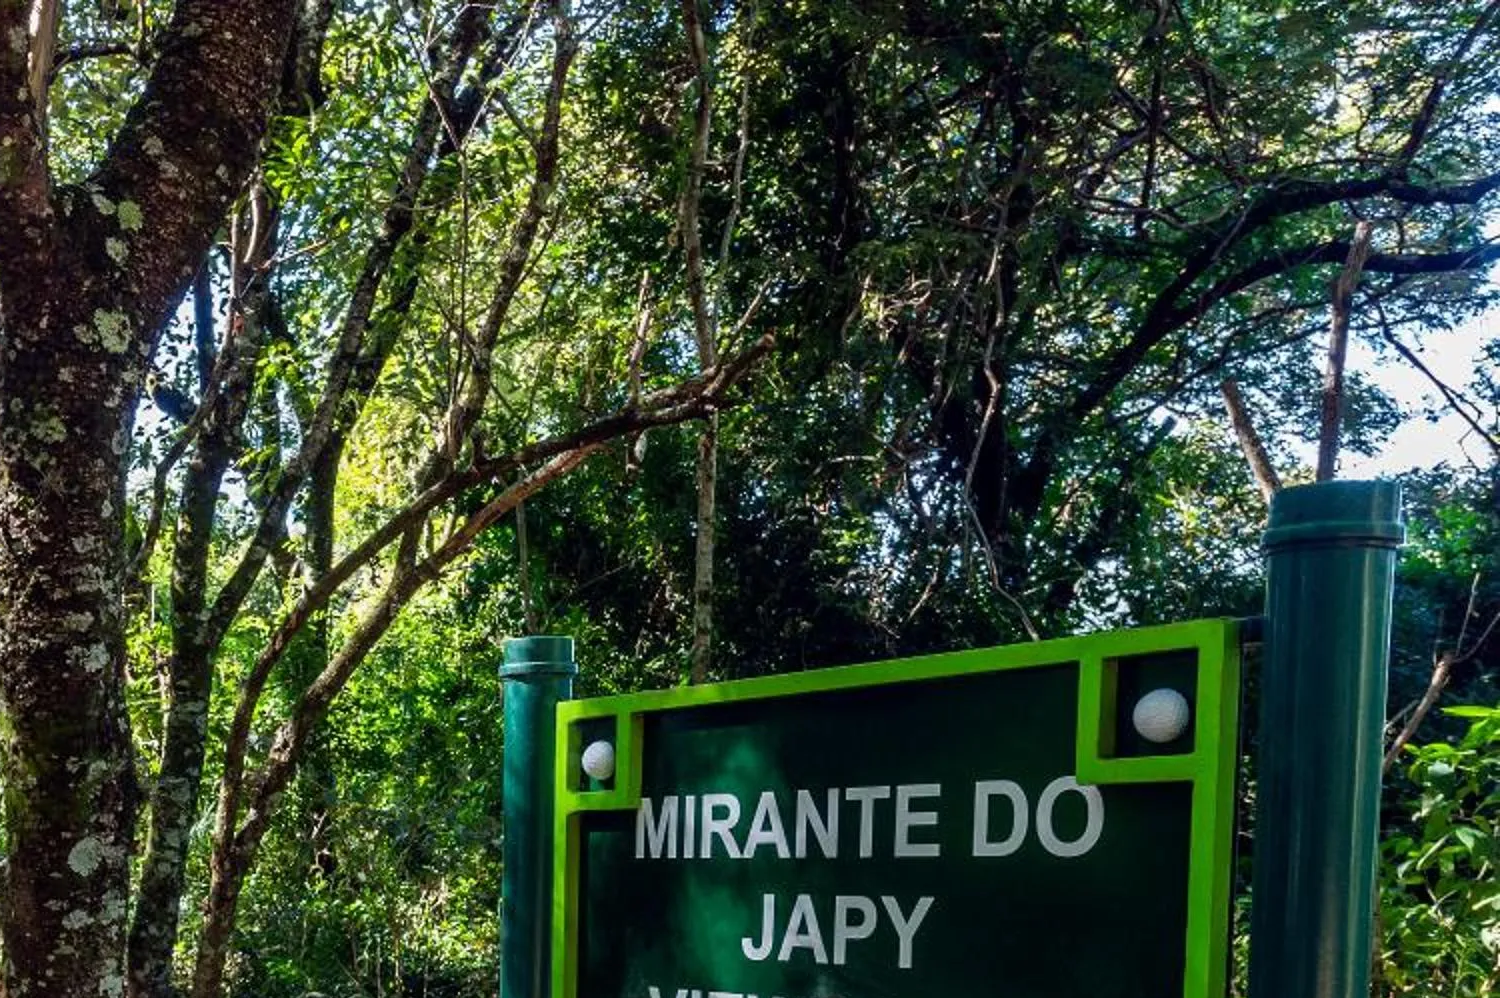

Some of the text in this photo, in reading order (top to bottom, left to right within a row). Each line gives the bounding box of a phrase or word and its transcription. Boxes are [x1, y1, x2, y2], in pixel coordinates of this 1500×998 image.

[634, 775, 1105, 860] MIRANTE DO
[741, 893, 935, 969] JAPY
